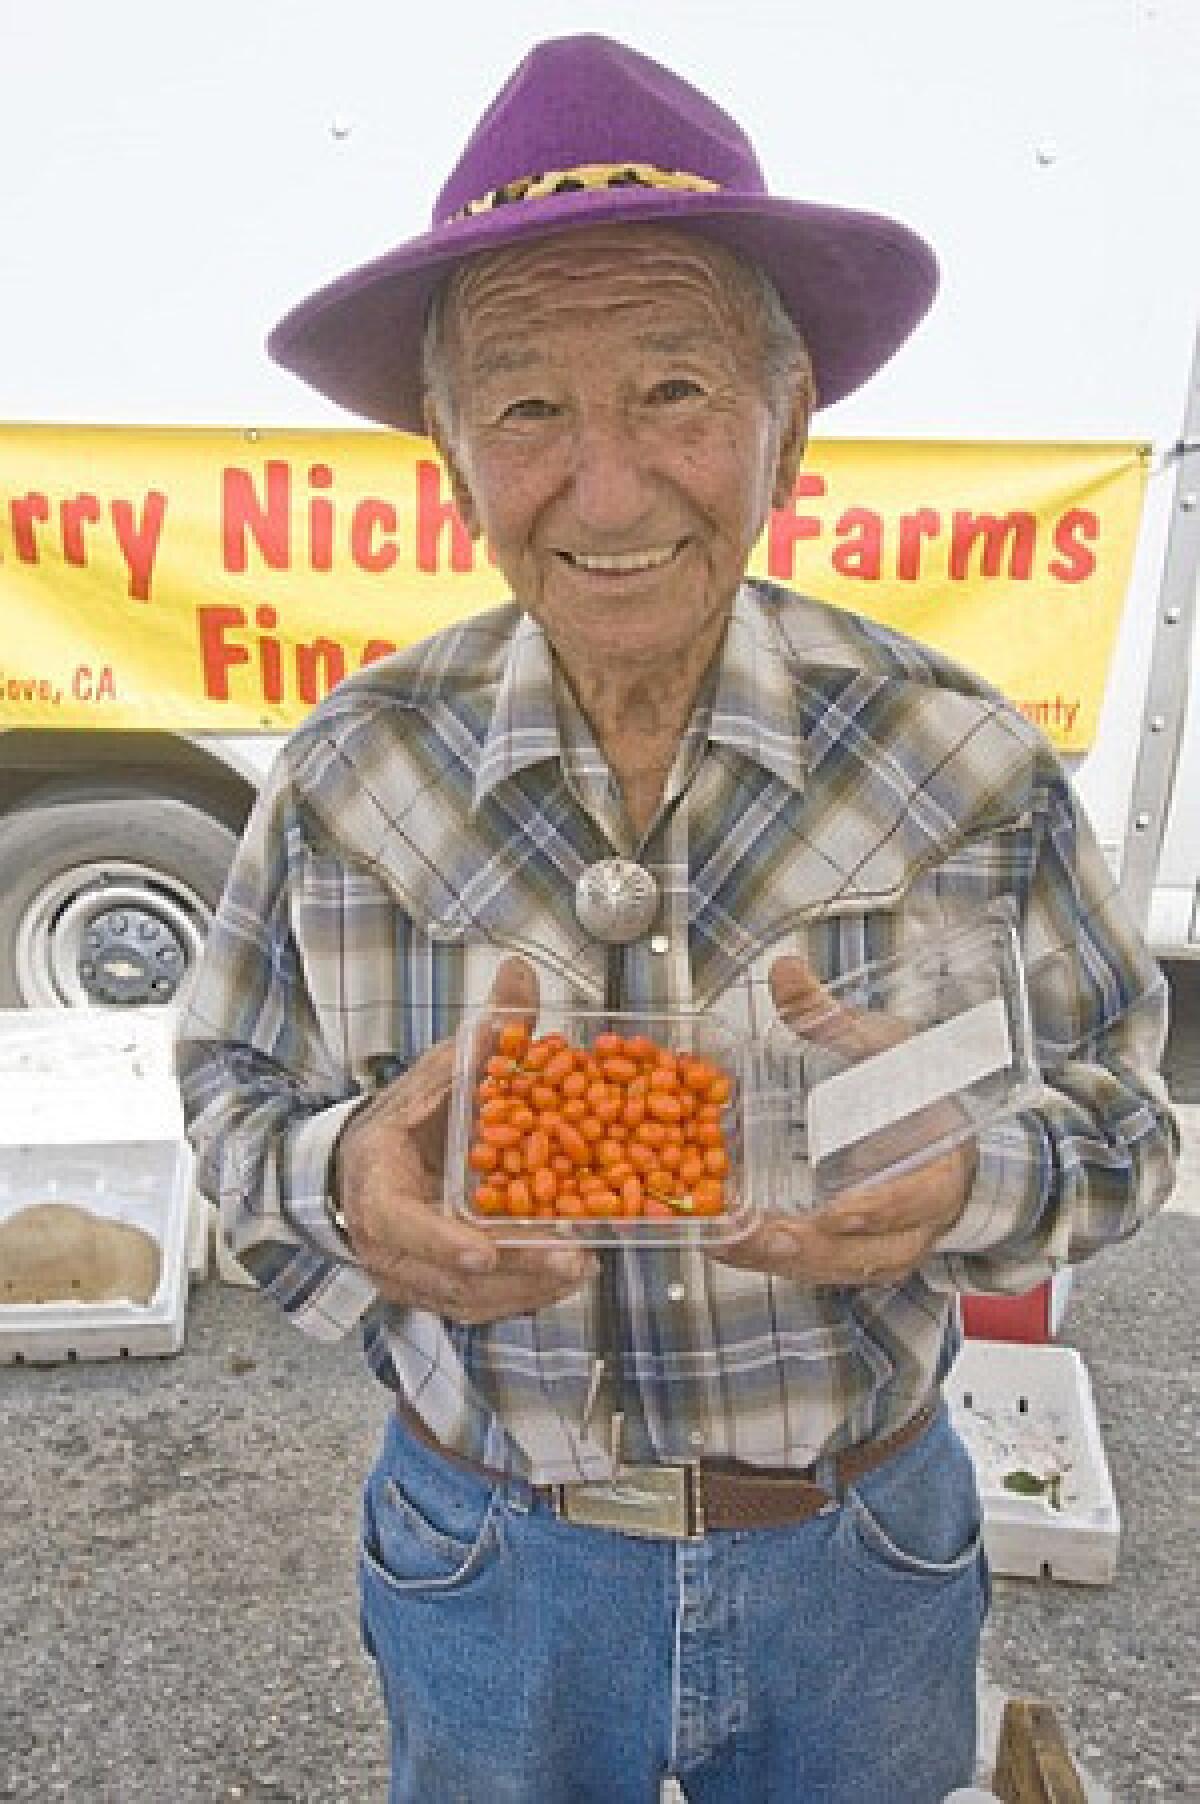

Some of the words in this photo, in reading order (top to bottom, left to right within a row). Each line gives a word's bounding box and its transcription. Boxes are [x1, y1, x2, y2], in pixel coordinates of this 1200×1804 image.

[0, 489, 167, 604] rry
[221, 459, 497, 575] Nich
[768, 473, 1100, 583] Farms
[0, 672, 63, 704] ove,
[72, 664, 116, 701] CA
